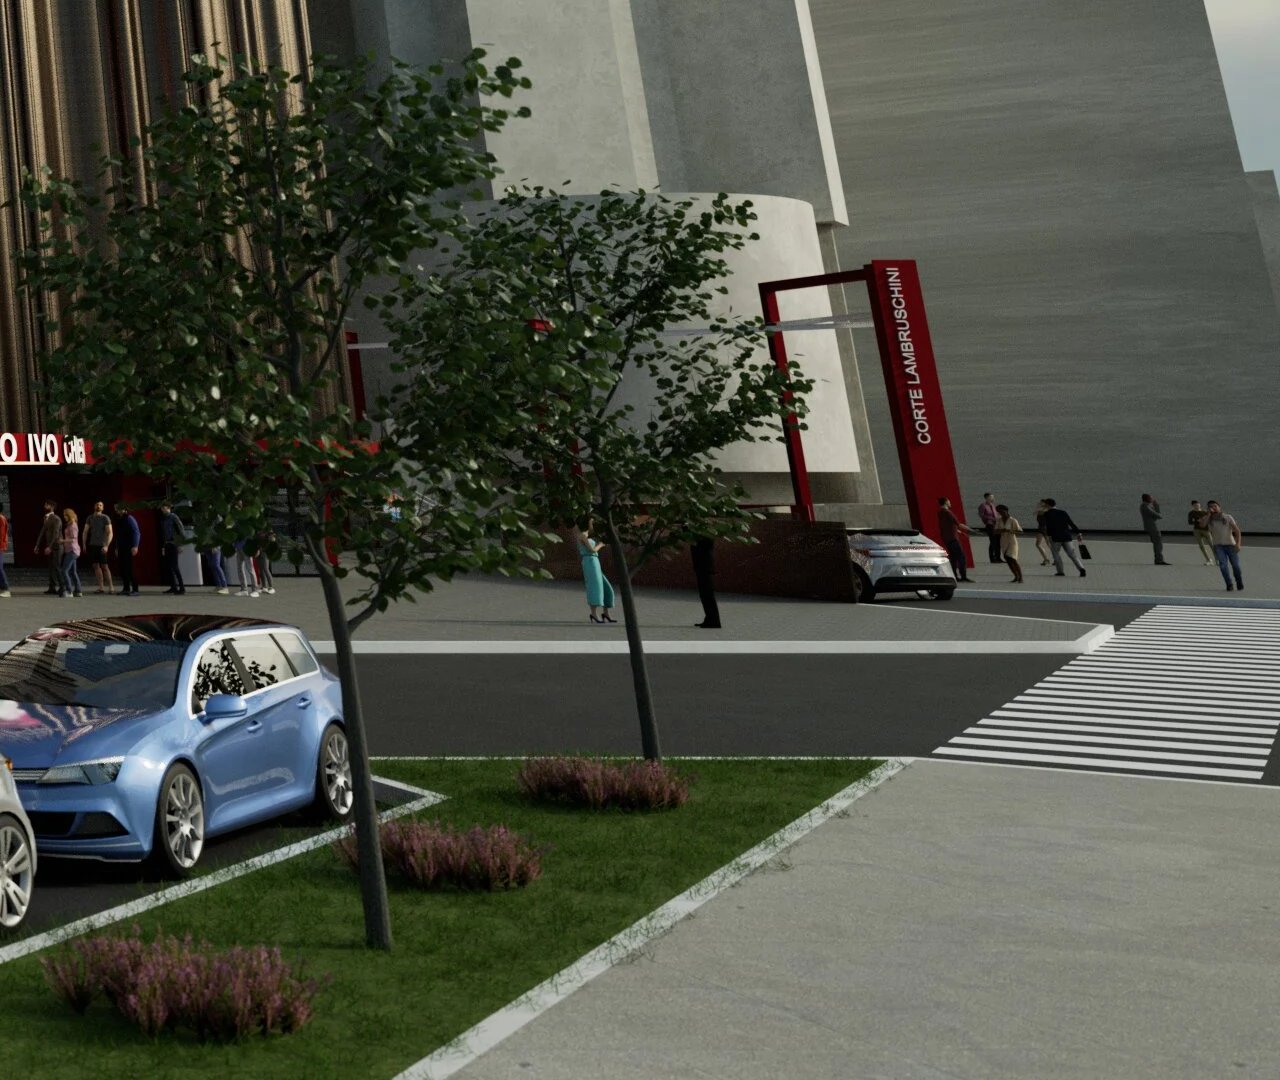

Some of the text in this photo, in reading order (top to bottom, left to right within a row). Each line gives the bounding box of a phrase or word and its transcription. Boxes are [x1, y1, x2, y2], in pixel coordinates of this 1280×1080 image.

[886, 267, 932, 445] CORTE LAMBRUSCHINI
[27, 433, 58, 464] IVO
